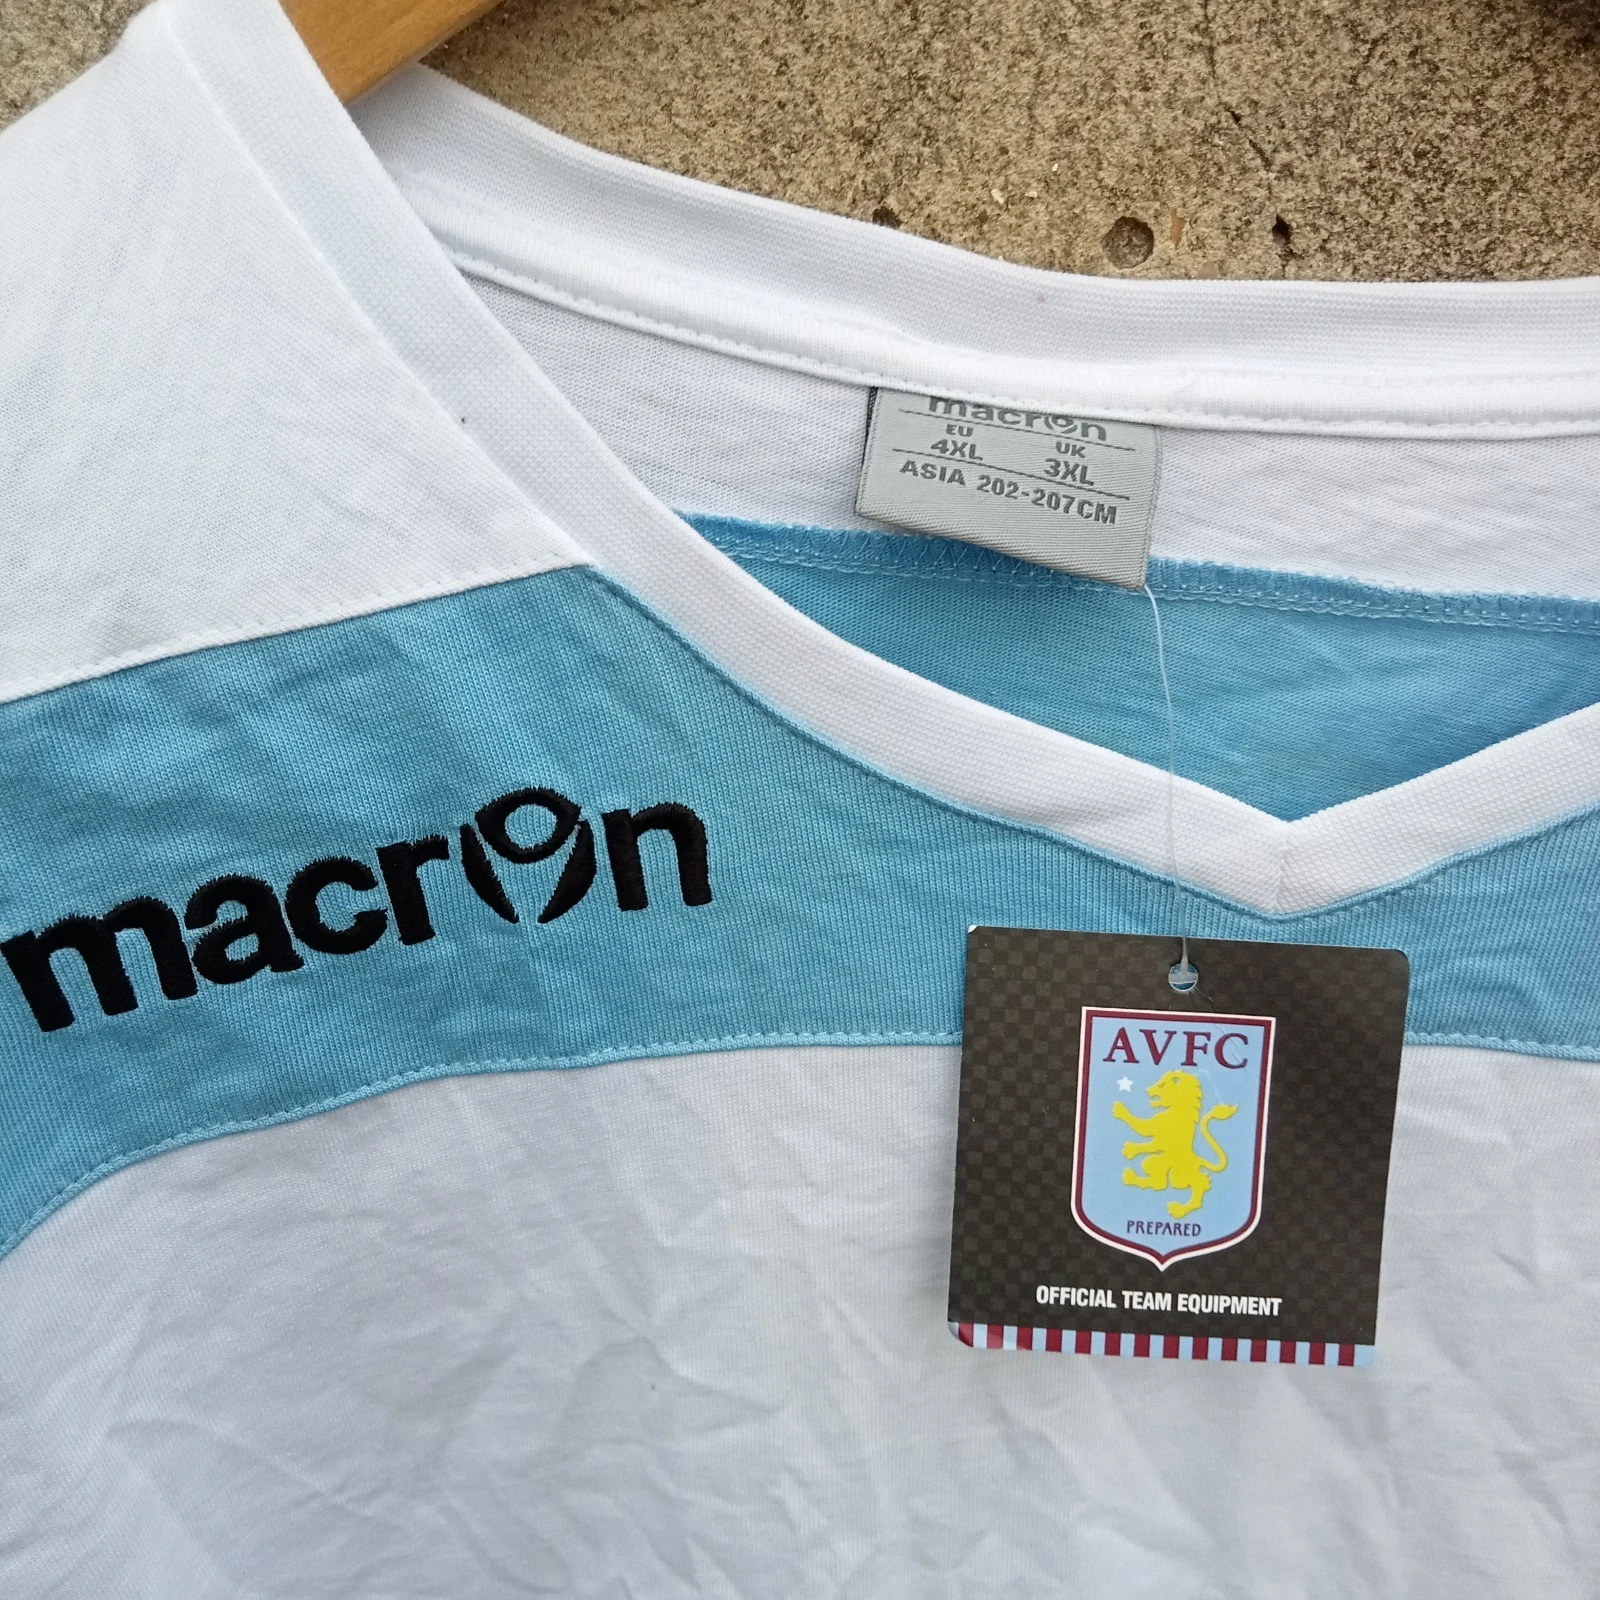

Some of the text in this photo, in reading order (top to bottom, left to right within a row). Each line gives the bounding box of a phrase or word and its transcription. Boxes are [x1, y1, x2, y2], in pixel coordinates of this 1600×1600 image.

[930, 396, 1107, 441] macron
[931, 438, 1095, 487] 4XL 3XL
[945, 424, 1086, 458] EU UK
[899, 460, 1118, 525] ASIA 202-207CM
[1, 786, 713, 1032] macron
[1102, 1027, 1249, 1070] AVFC
[1126, 1219, 1202, 1238] PREPARED
[1036, 1285, 1283, 1316] OFFICIAL TEAM EQUIPMENT
